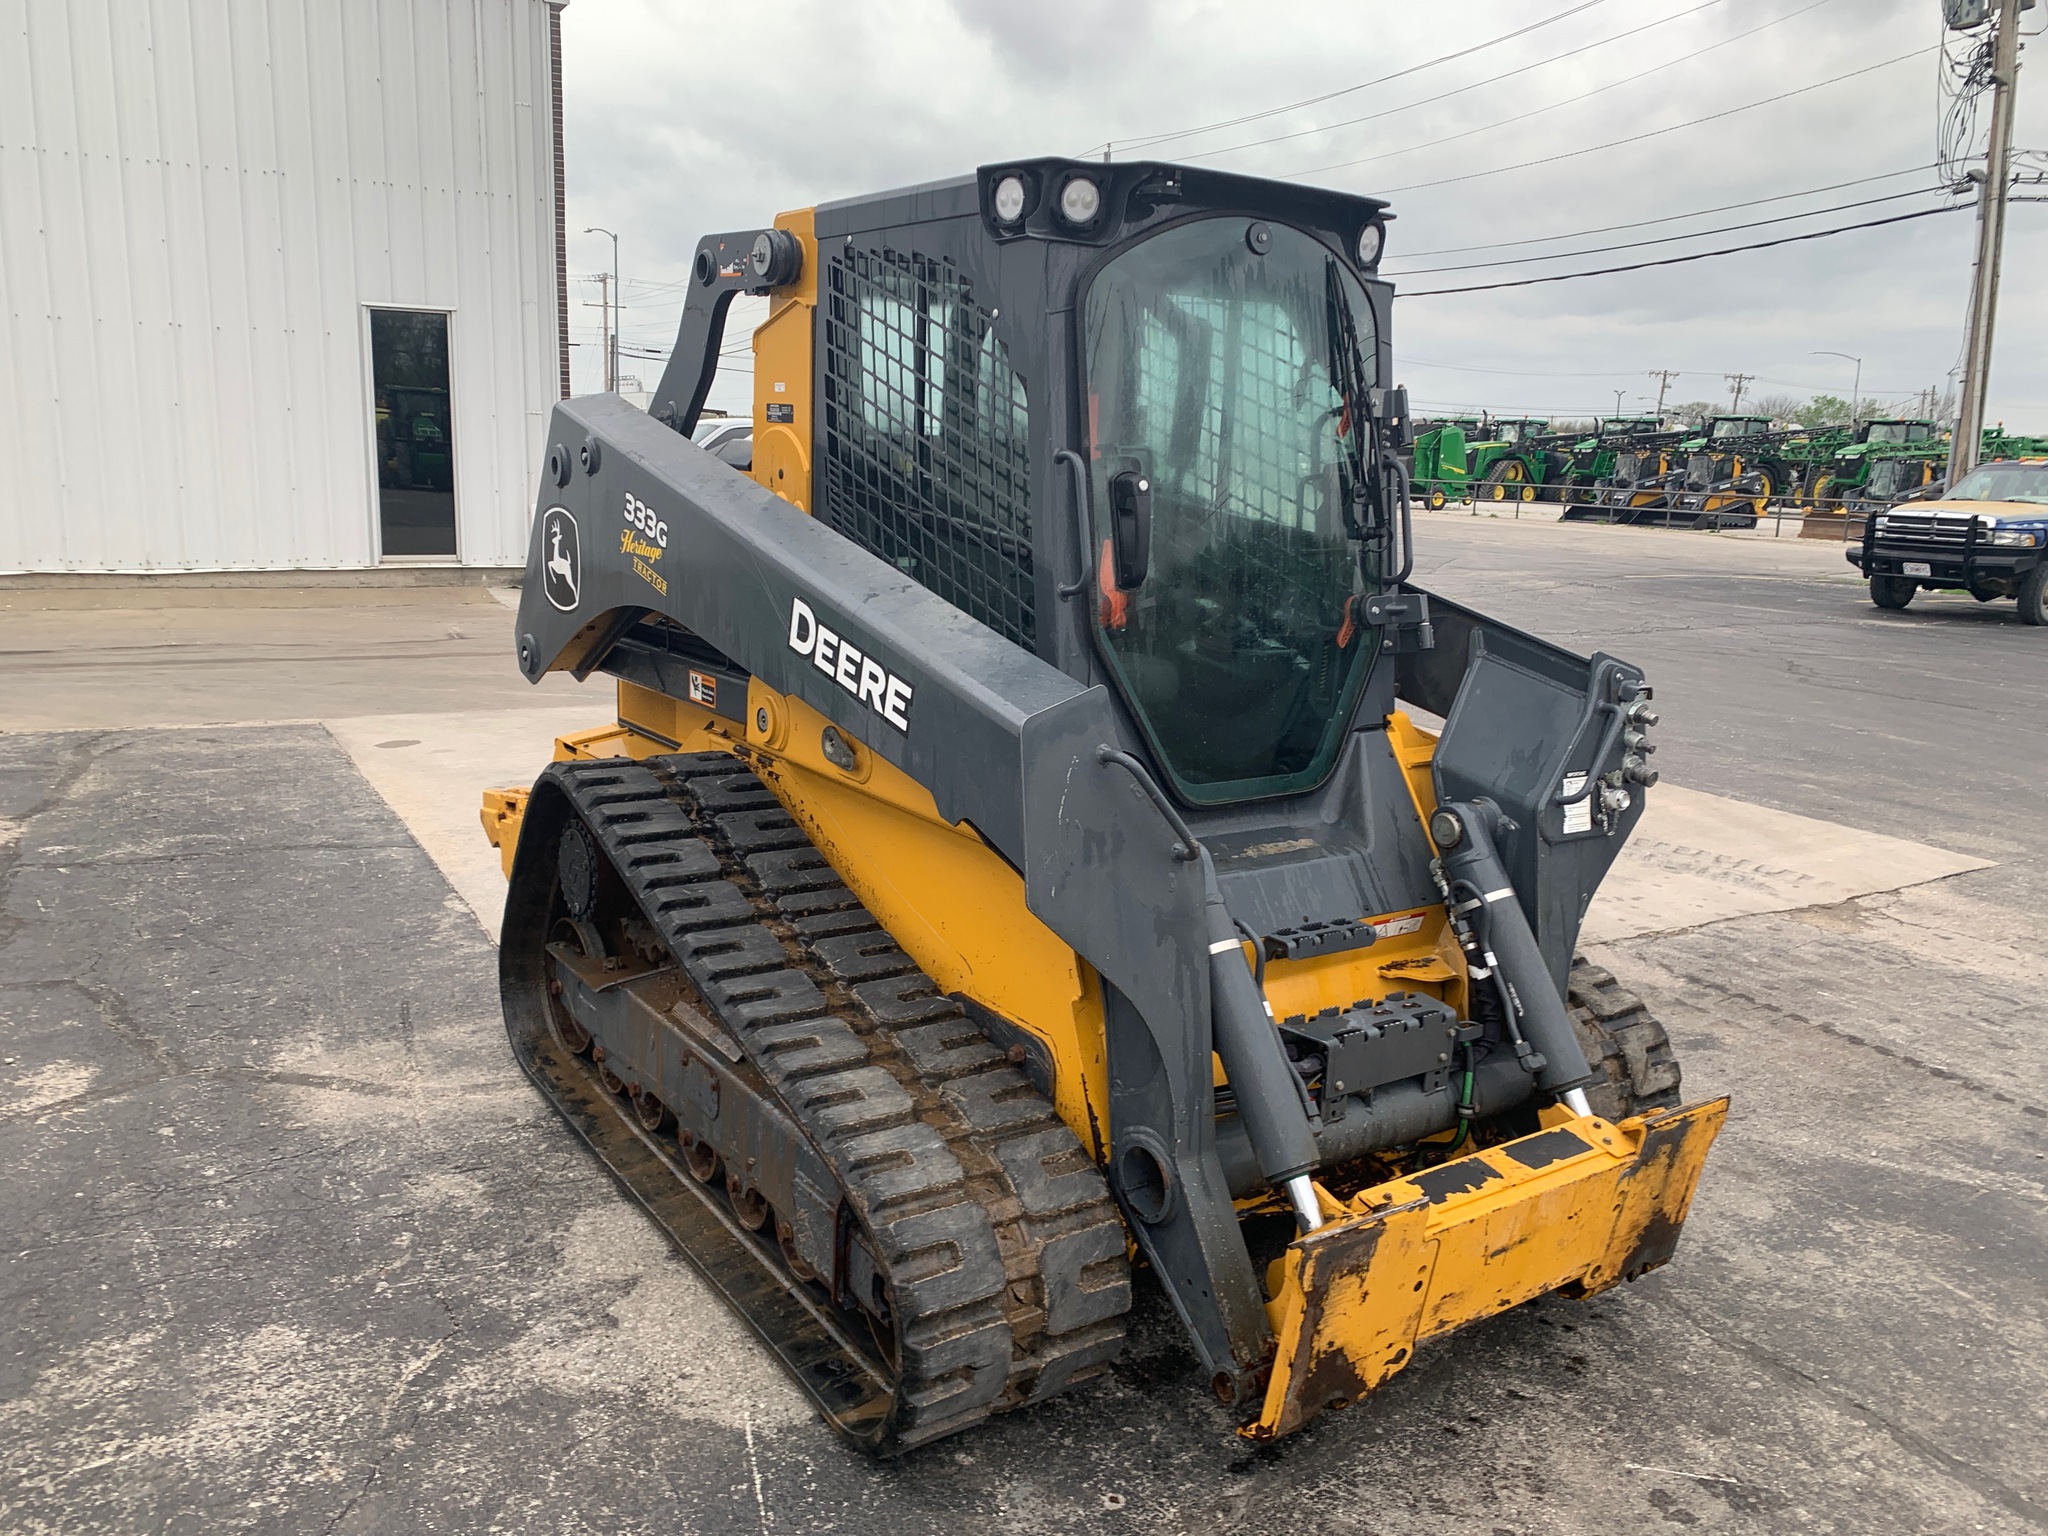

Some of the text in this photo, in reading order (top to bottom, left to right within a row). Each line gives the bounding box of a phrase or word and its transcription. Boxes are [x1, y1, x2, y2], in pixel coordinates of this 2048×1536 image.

[624, 492, 668, 548] 333G
[620, 528, 663, 564] Heritage
[633, 558, 667, 594] TRACTOR
[789, 597, 913, 732] DEERE
